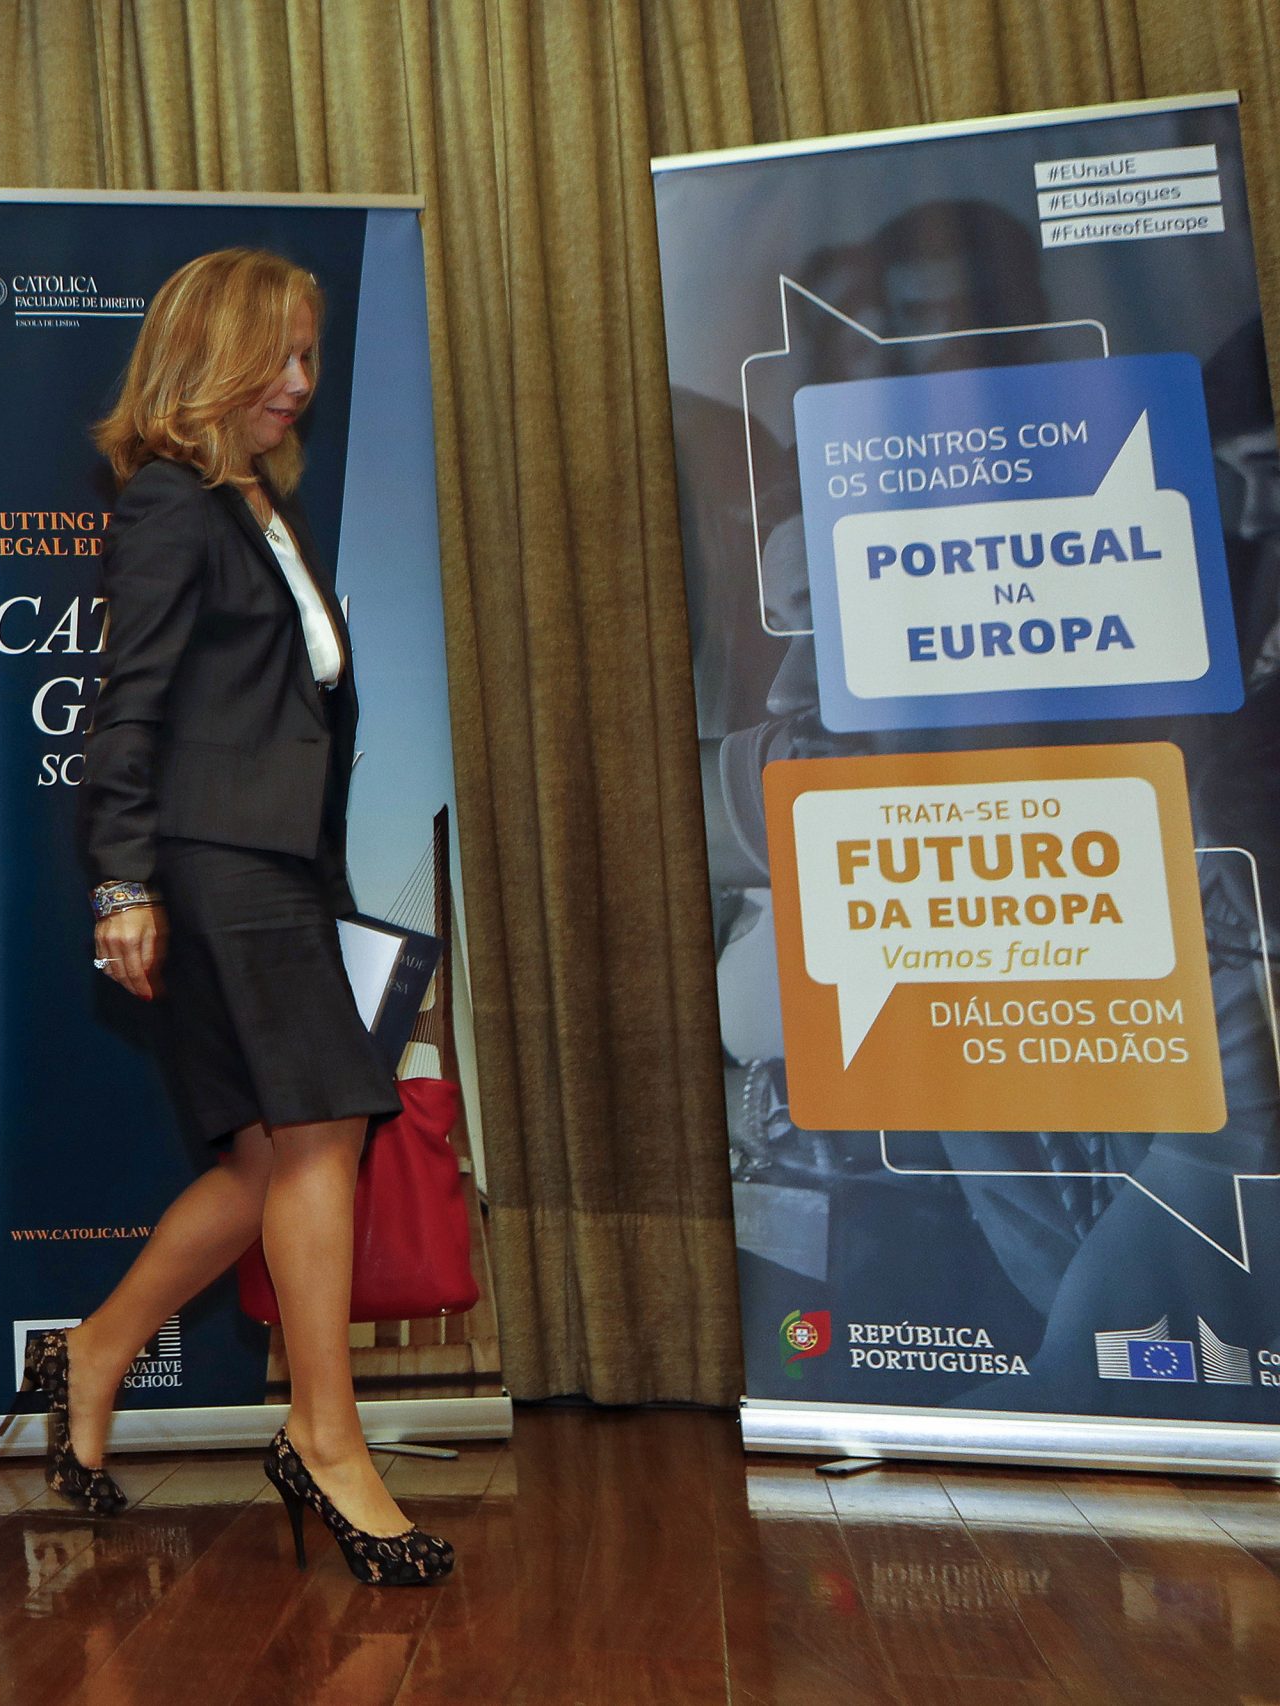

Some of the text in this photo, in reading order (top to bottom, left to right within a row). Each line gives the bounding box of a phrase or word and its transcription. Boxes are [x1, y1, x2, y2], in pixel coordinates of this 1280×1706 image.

[1049, 158, 1136, 181] #EUnaUE
[1050, 186, 1181, 210] #EUdialogues
[1052, 216, 1208, 241] #FutureofEurope
[15, 296, 145, 308] FACULDADE DE DIREITO
[825, 420, 1089, 466] ENCONTROS COM
[827, 457, 1034, 499] OS CIDADÃOS
[73, 537, 104, 556] ED
[866, 525, 1162, 580] PORTUGAL
[994, 582, 1035, 605] NA
[906, 614, 1135, 662] EUROPA
[37, 753, 87, 787] SC
[880, 798, 1062, 825] TRATA-SE DO
[836, 830, 1121, 886] FUTURO
[847, 893, 1123, 931] DA EUROPA
[882, 940, 1091, 974] Vamos falar
[930, 996, 1184, 1028] DIÁLOGOS COM
[962, 1033, 1189, 1064] OS CIDADÃOS
[848, 1321, 995, 1349] REPÚBLICA
[125, 1361, 183, 1374] VATIVE
[849, 1349, 1031, 1376] PORTUGUESA
[1258, 1350, 1280, 1366] Co
[124, 1375, 183, 1388] SCHOOL
[1260, 1370, 1280, 1386] Eu
